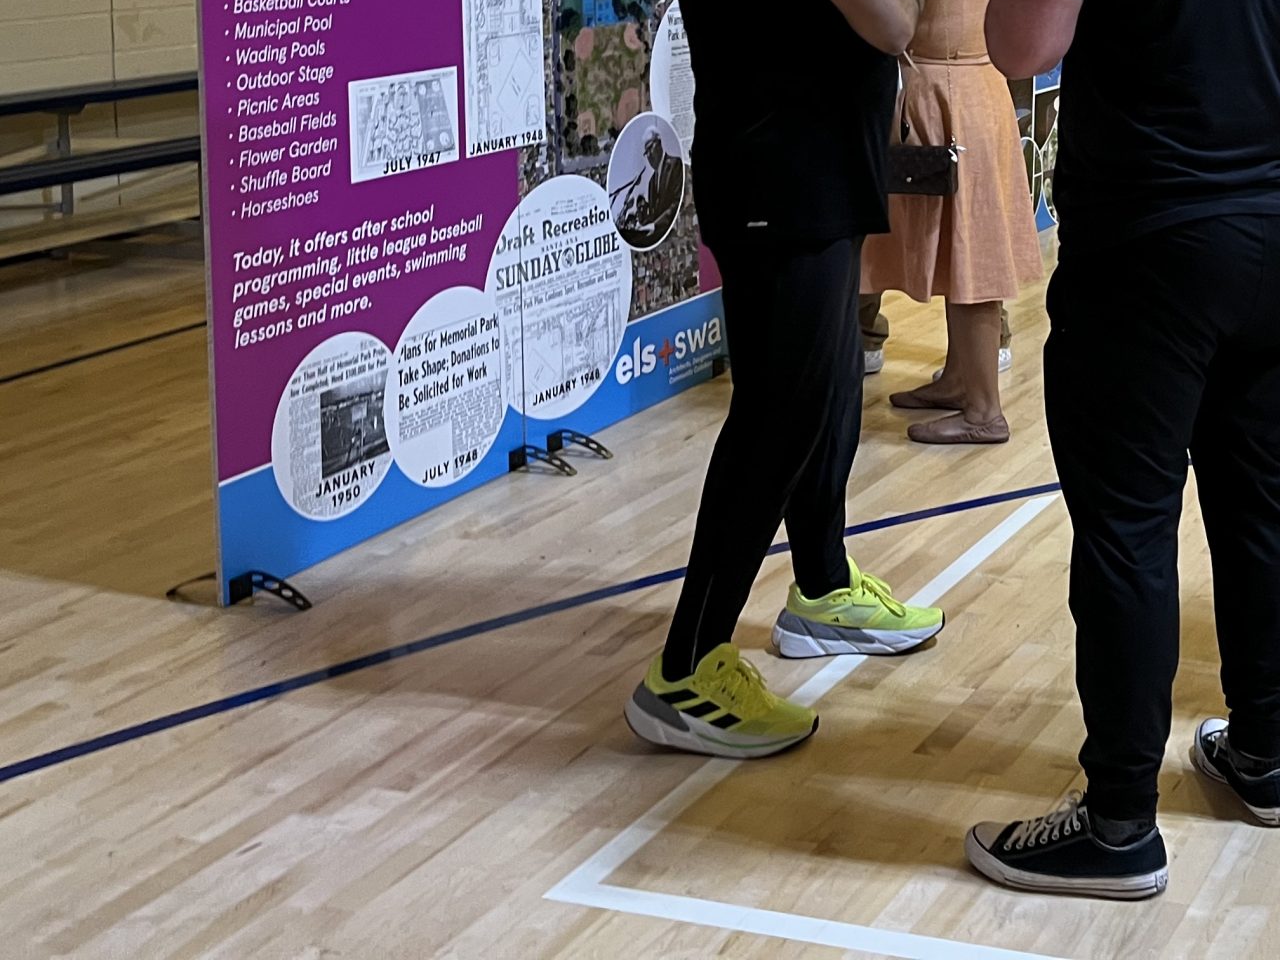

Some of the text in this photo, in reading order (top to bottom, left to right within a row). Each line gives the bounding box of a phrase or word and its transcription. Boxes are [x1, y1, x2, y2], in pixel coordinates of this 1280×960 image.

[235, 14, 332, 40] Municipal Pool
[236, 40, 325, 65] Wading Pools
[237, 66, 333, 91] Outdoor Stage
[238, 92, 319, 117] Picnic Areas
[239, 111, 336, 142] Baseball Fields
[240, 137, 337, 168] Flower Garden
[470, 129, 544, 156] JANUARY 1948
[240, 159, 331, 193] Shuffle Board
[383, 151, 441, 175] JULY 1947
[241, 190, 318, 219] Horseshoes
[496, 248, 562, 291] SUNDAY
[576, 231, 620, 265] GLOBE
[398, 338, 499, 387] Take Shape; Donations to
[398, 363, 487, 411] Be Solicited for Work
[533, 369, 600, 406] JANUARY 1948
[316, 461, 376, 497] JANUARY
[422, 451, 478, 483] JULY 1948
[332, 486, 361, 507] 1950
